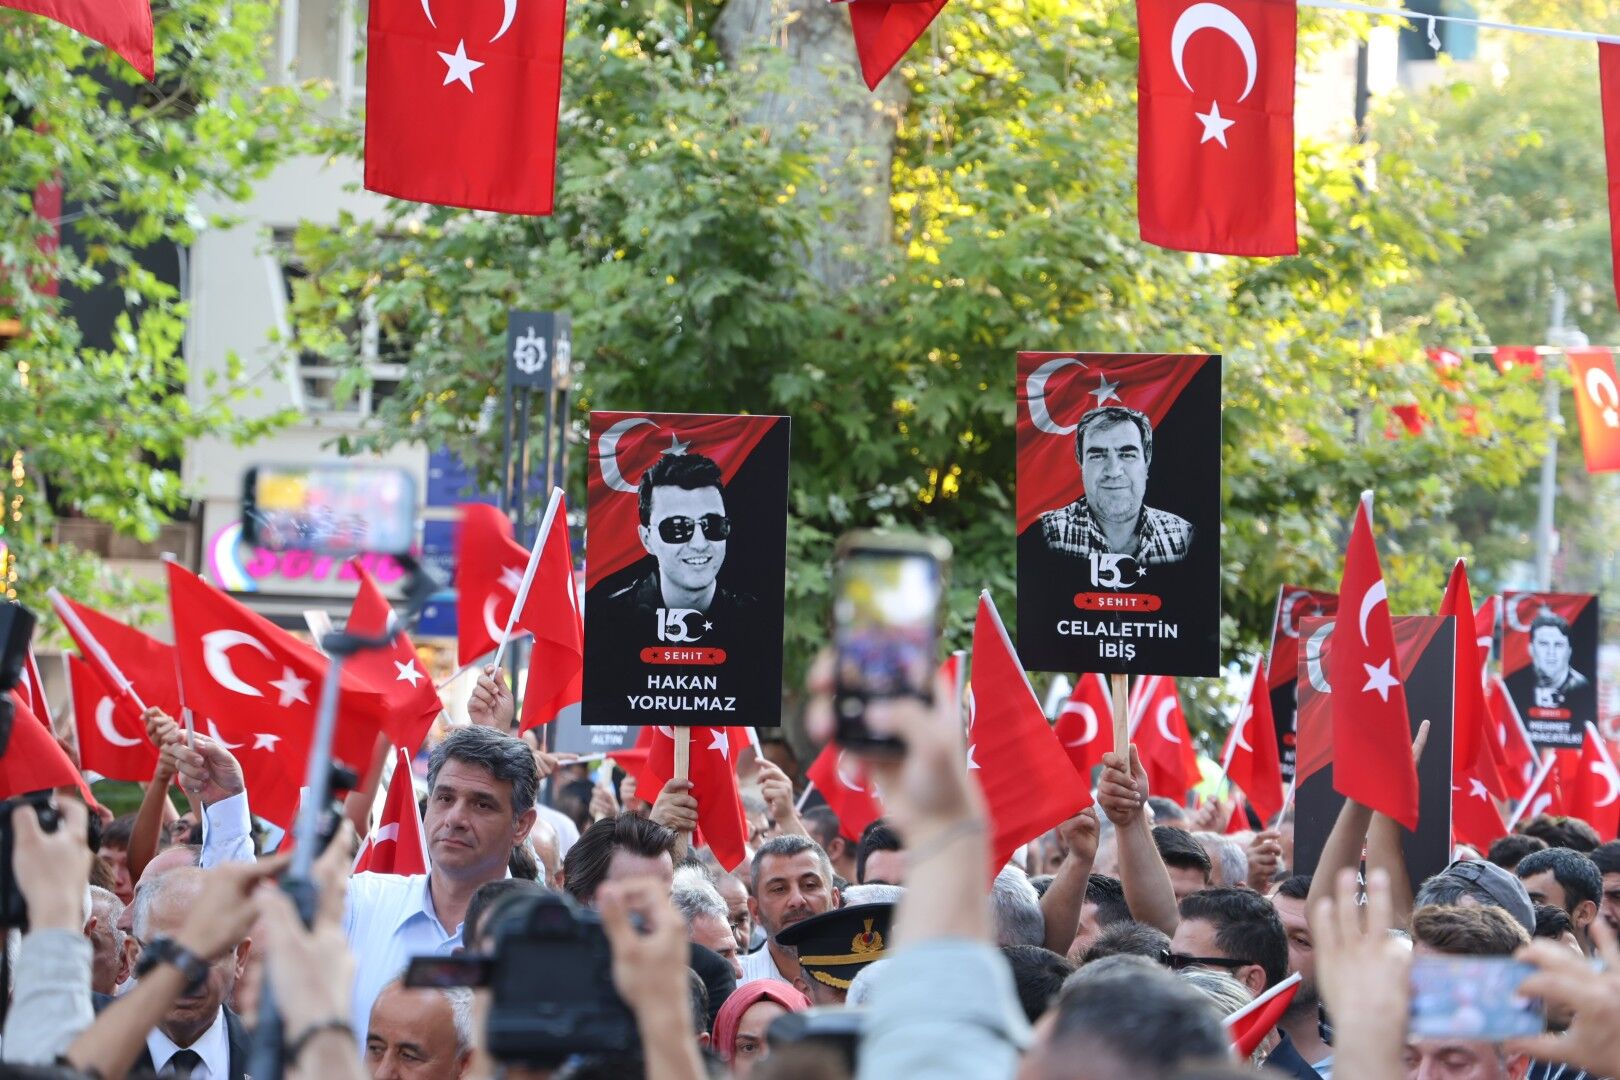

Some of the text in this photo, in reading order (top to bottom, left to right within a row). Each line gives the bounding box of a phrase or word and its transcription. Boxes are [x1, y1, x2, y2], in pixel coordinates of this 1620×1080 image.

[1098, 597, 1138, 607] ŞEHİT
[1056, 620, 1178, 638] CELALETTİN
[664, 651, 703, 661] ŞEHİT
[1099, 640, 1136, 661] İBİŞ
[647, 675, 717, 690] HAKAN
[627, 695, 737, 711] YORULMAZ
